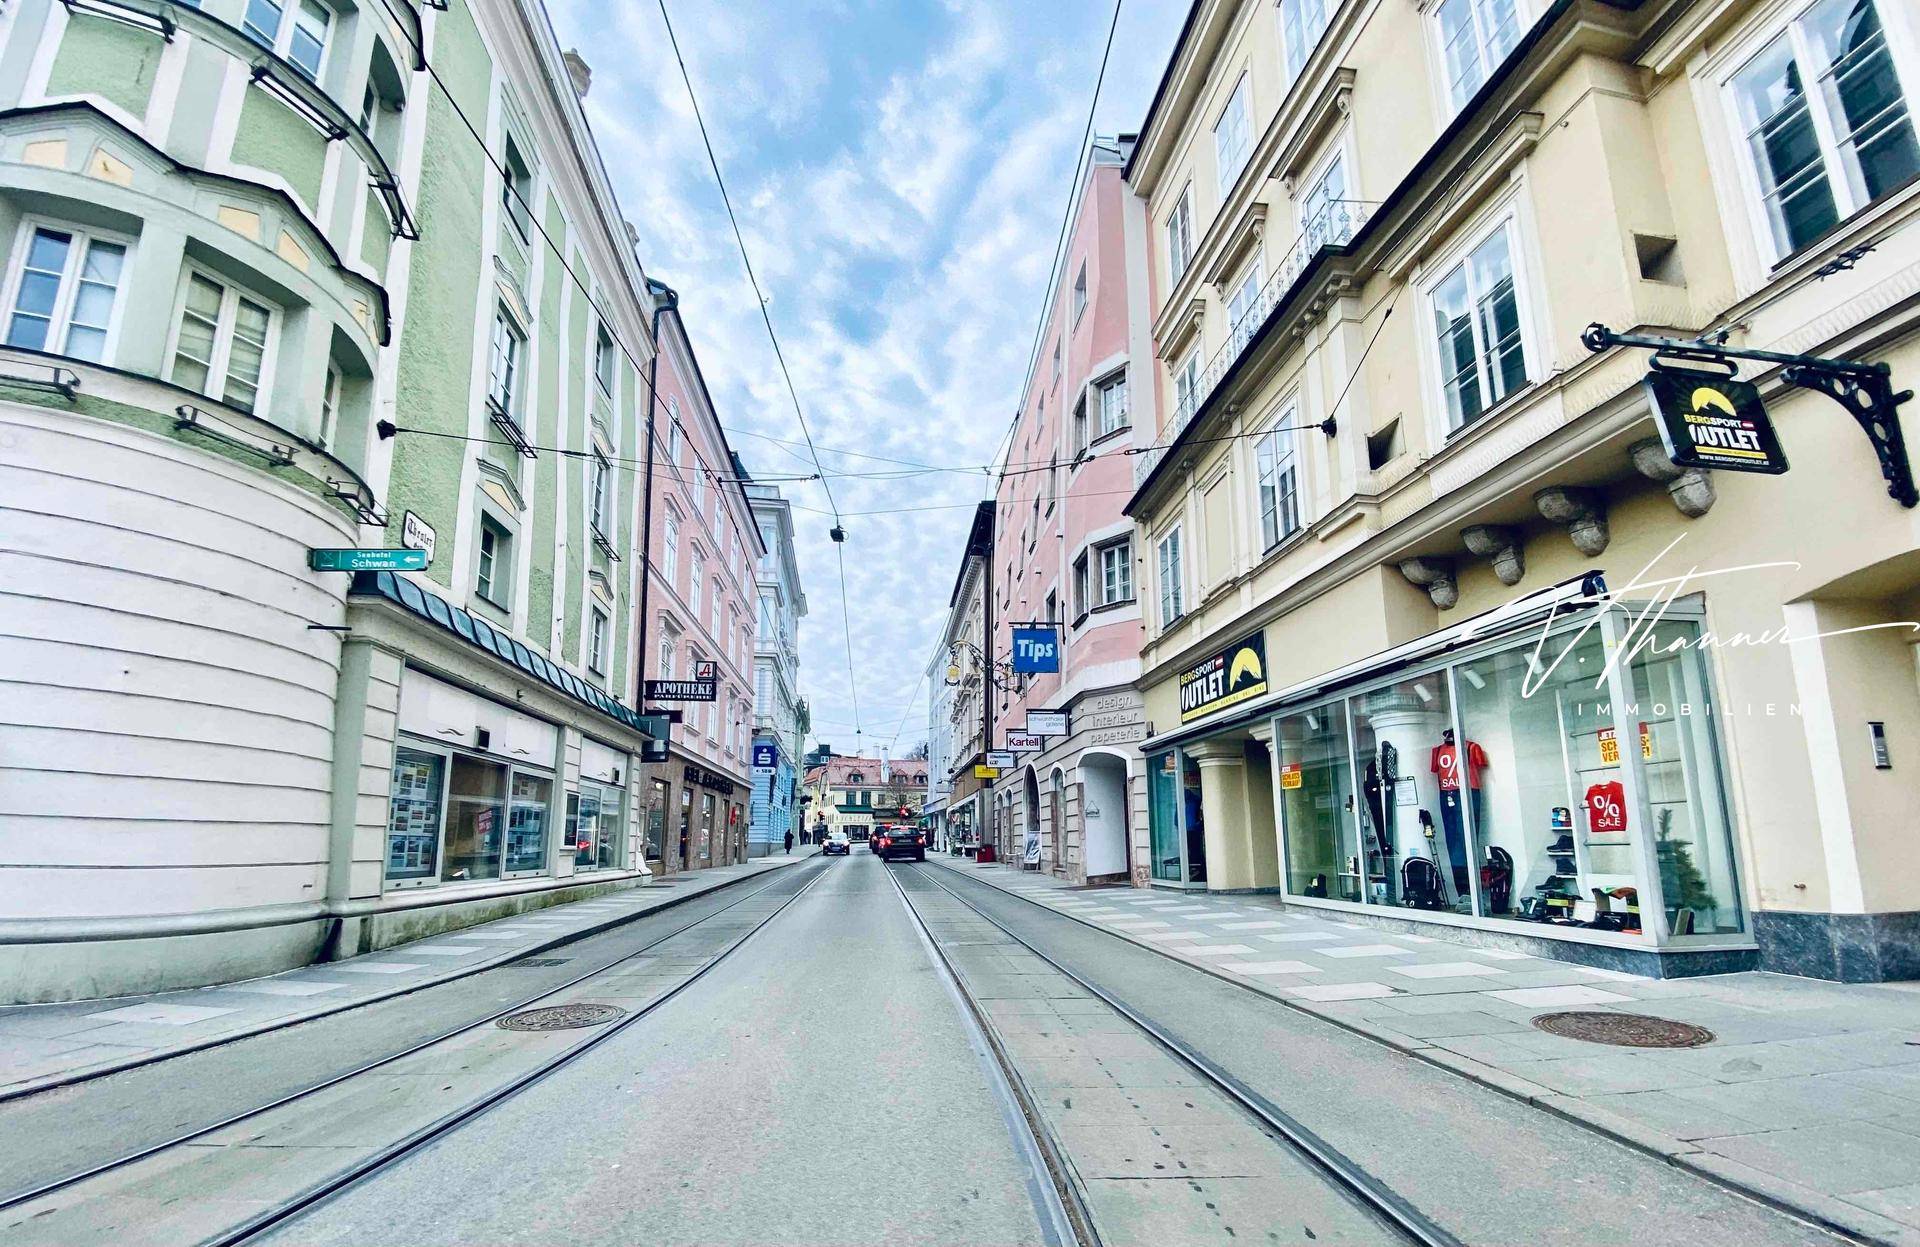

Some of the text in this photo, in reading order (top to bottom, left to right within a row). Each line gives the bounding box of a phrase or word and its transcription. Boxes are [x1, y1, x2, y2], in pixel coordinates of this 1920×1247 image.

[1684, 414, 1741, 428] BERGSPORT
[1688, 424, 1760, 450] OUTLET
[351, 559, 396, 568] Schwan
[1017, 639, 1054, 663] Tips
[1180, 659, 1216, 686] BERGSPORT
[654, 682, 713, 695] APOTHEKE
[1181, 668, 1224, 711] OUTLET
[1097, 696, 1132, 709] design
[1092, 712, 1137, 727] interieur
[1009, 737, 1039, 747] Kartell
[1091, 727, 1140, 747] papeterie
[1442, 778, 1460, 788] SAL
[1598, 817, 1621, 828] SALE
